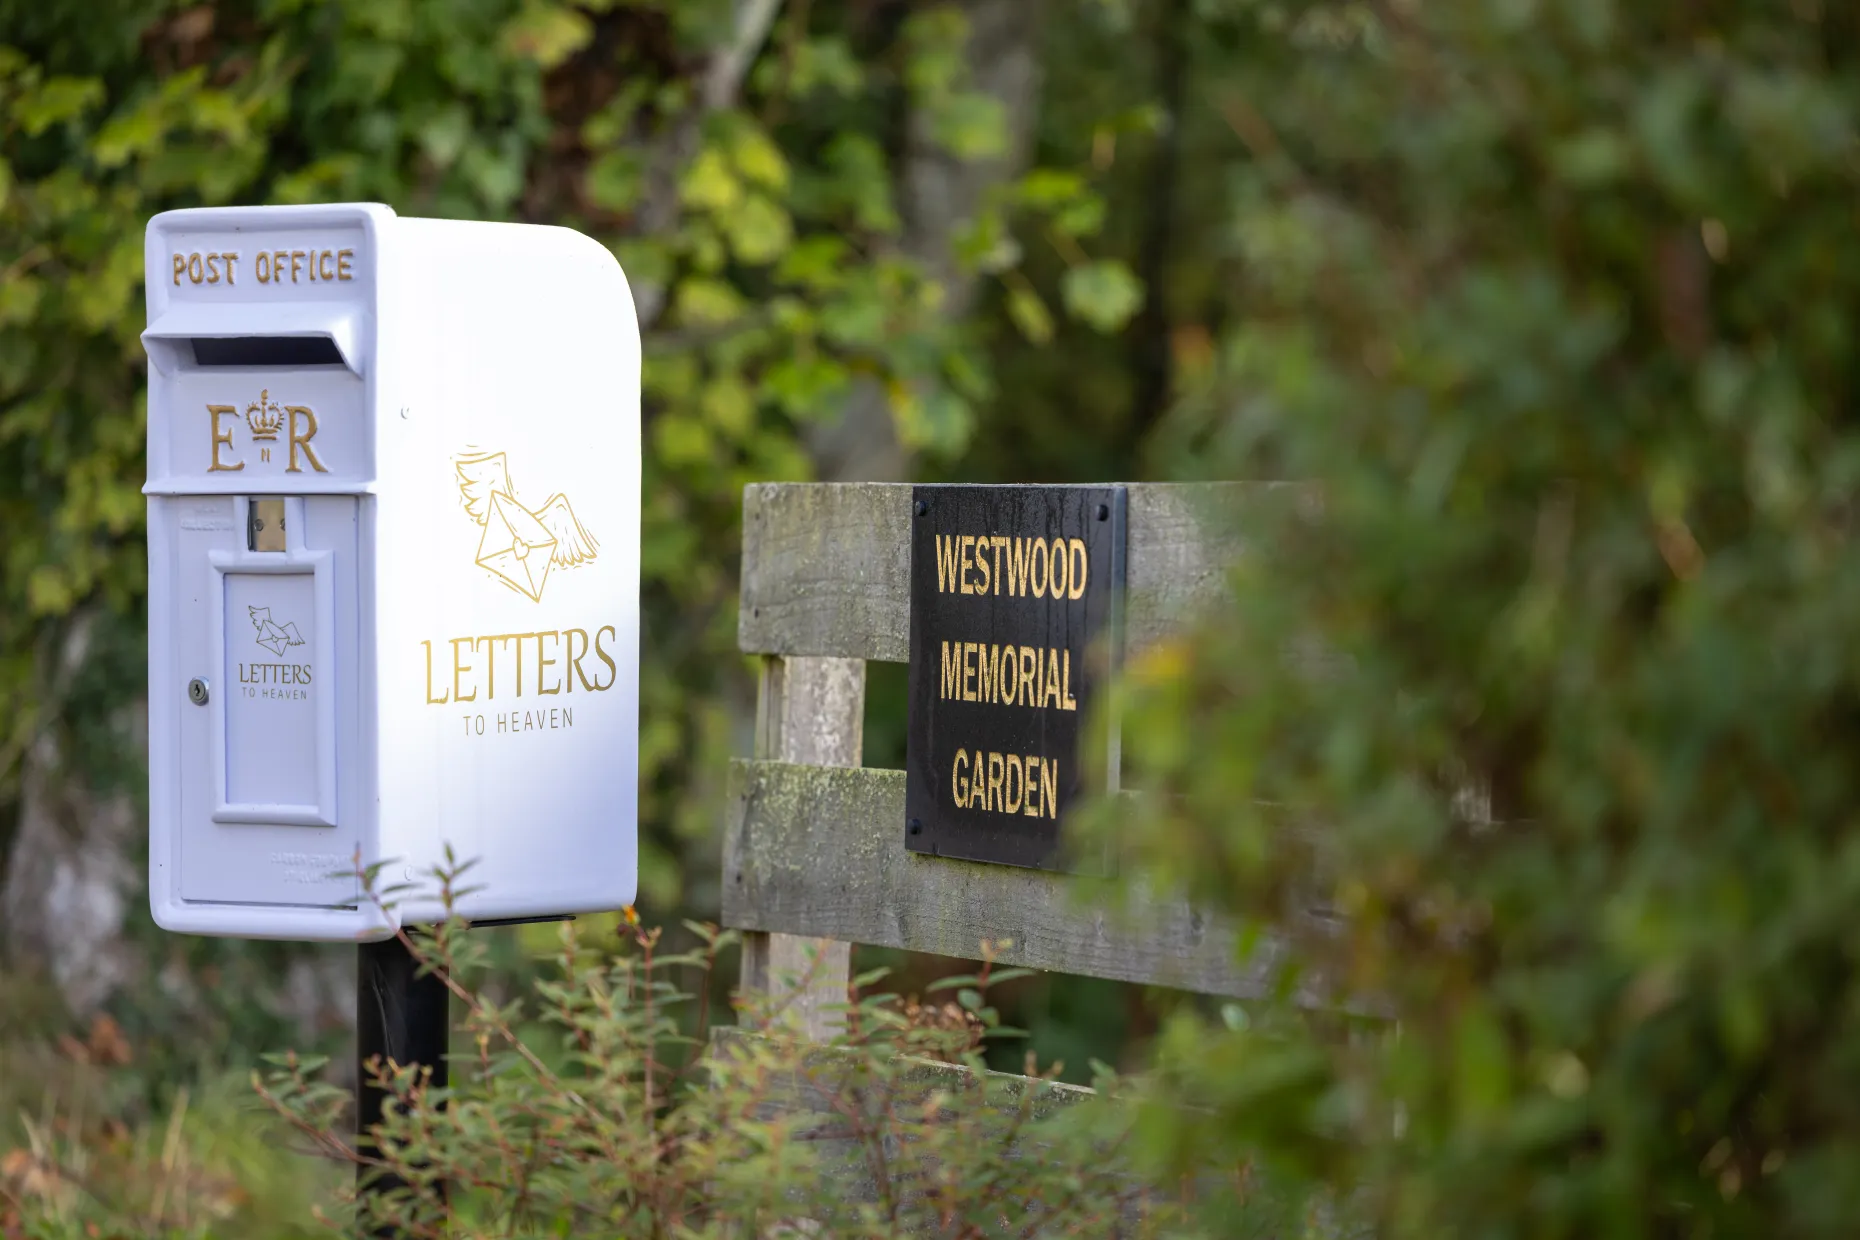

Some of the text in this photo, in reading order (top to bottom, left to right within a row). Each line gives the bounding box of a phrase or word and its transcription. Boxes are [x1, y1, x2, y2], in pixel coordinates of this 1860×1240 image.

[173, 249, 353, 286] POST OFFICE
[935, 534, 1088, 600] WESTWOOD
[238, 663, 312, 684] LETTERS
[420, 625, 617, 705] LETTERS
[940, 640, 1077, 711] MEMORIAL
[242, 687, 307, 700] TO HEAVEN
[463, 707, 573, 736] TO HEAVEN
[952, 748, 1059, 819] GARDEN
